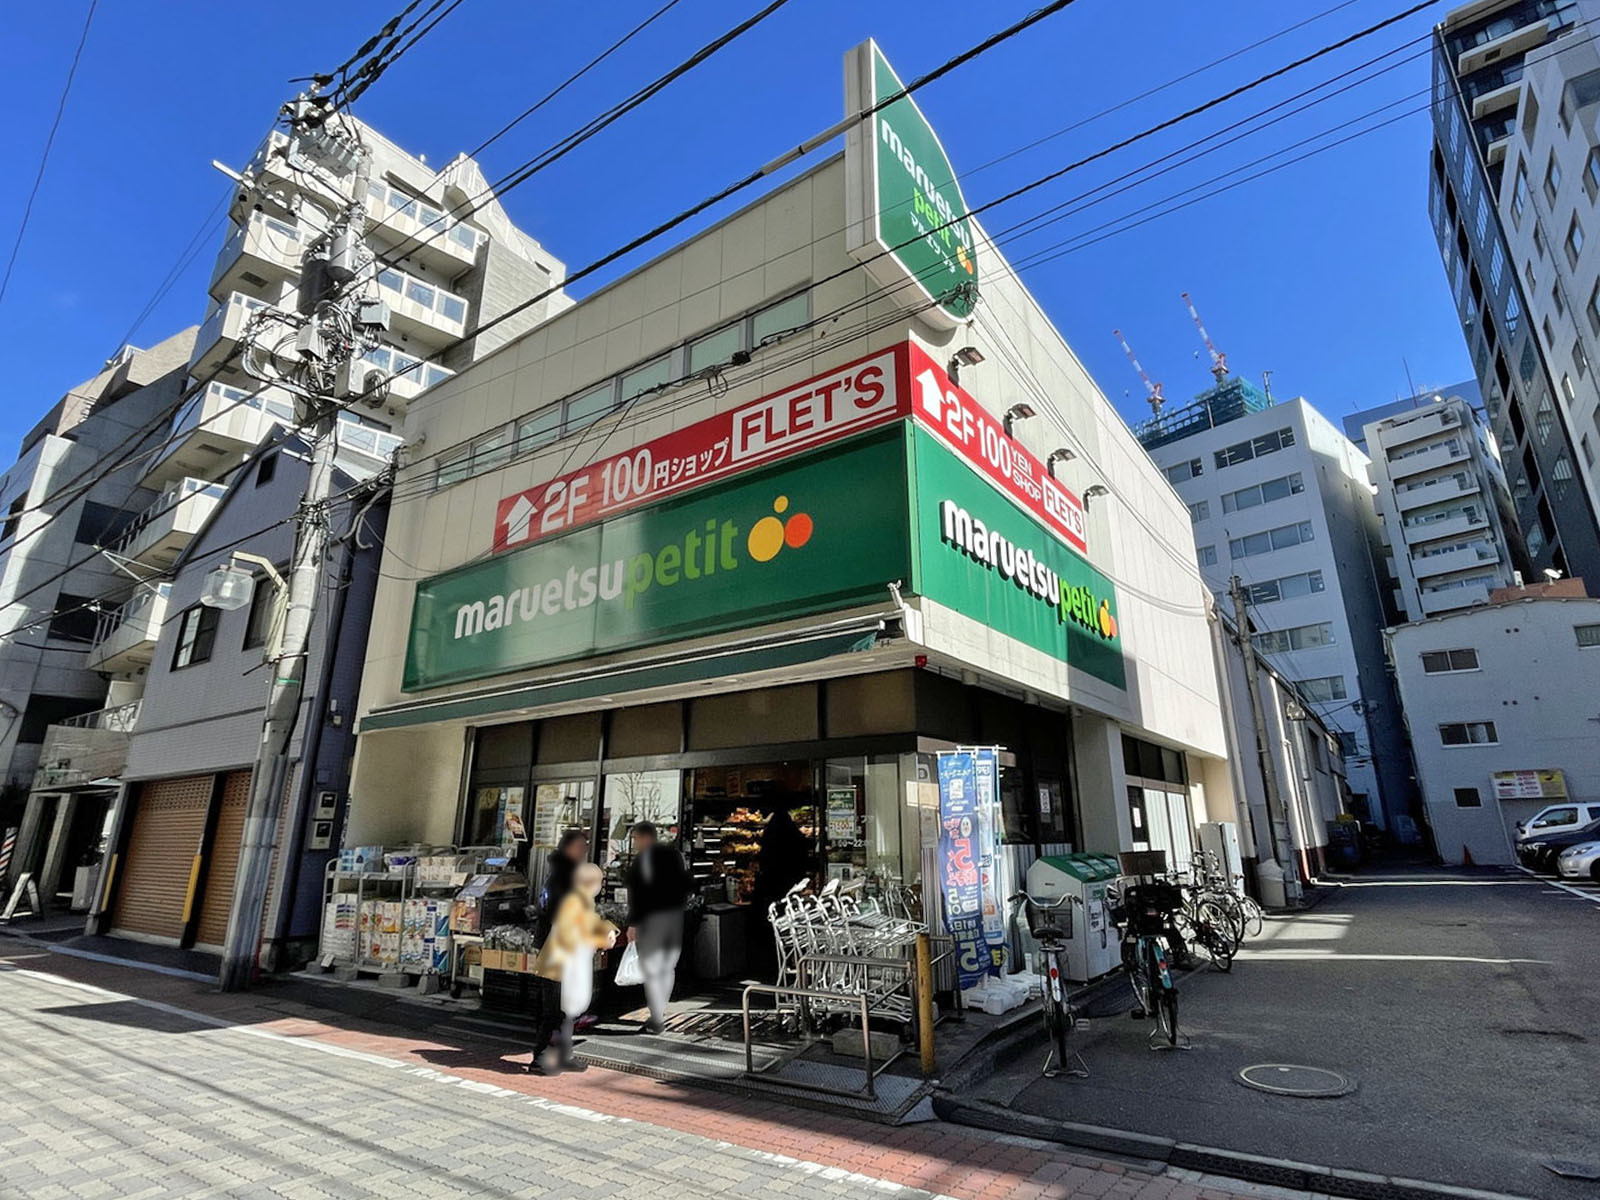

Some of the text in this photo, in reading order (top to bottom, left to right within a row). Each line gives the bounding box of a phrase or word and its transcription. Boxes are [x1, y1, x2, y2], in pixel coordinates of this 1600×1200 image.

[881, 118, 971, 252] maruetsu
[913, 186, 952, 249] petit
[540, 474, 590, 534] 2F
[740, 366, 886, 454] FLET'S
[945, 390, 1083, 536] 2F 100 YEN SHOP FLET'S
[454, 517, 739, 639] maruetsu petit
[943, 499, 1100, 631] maruetsu petit
